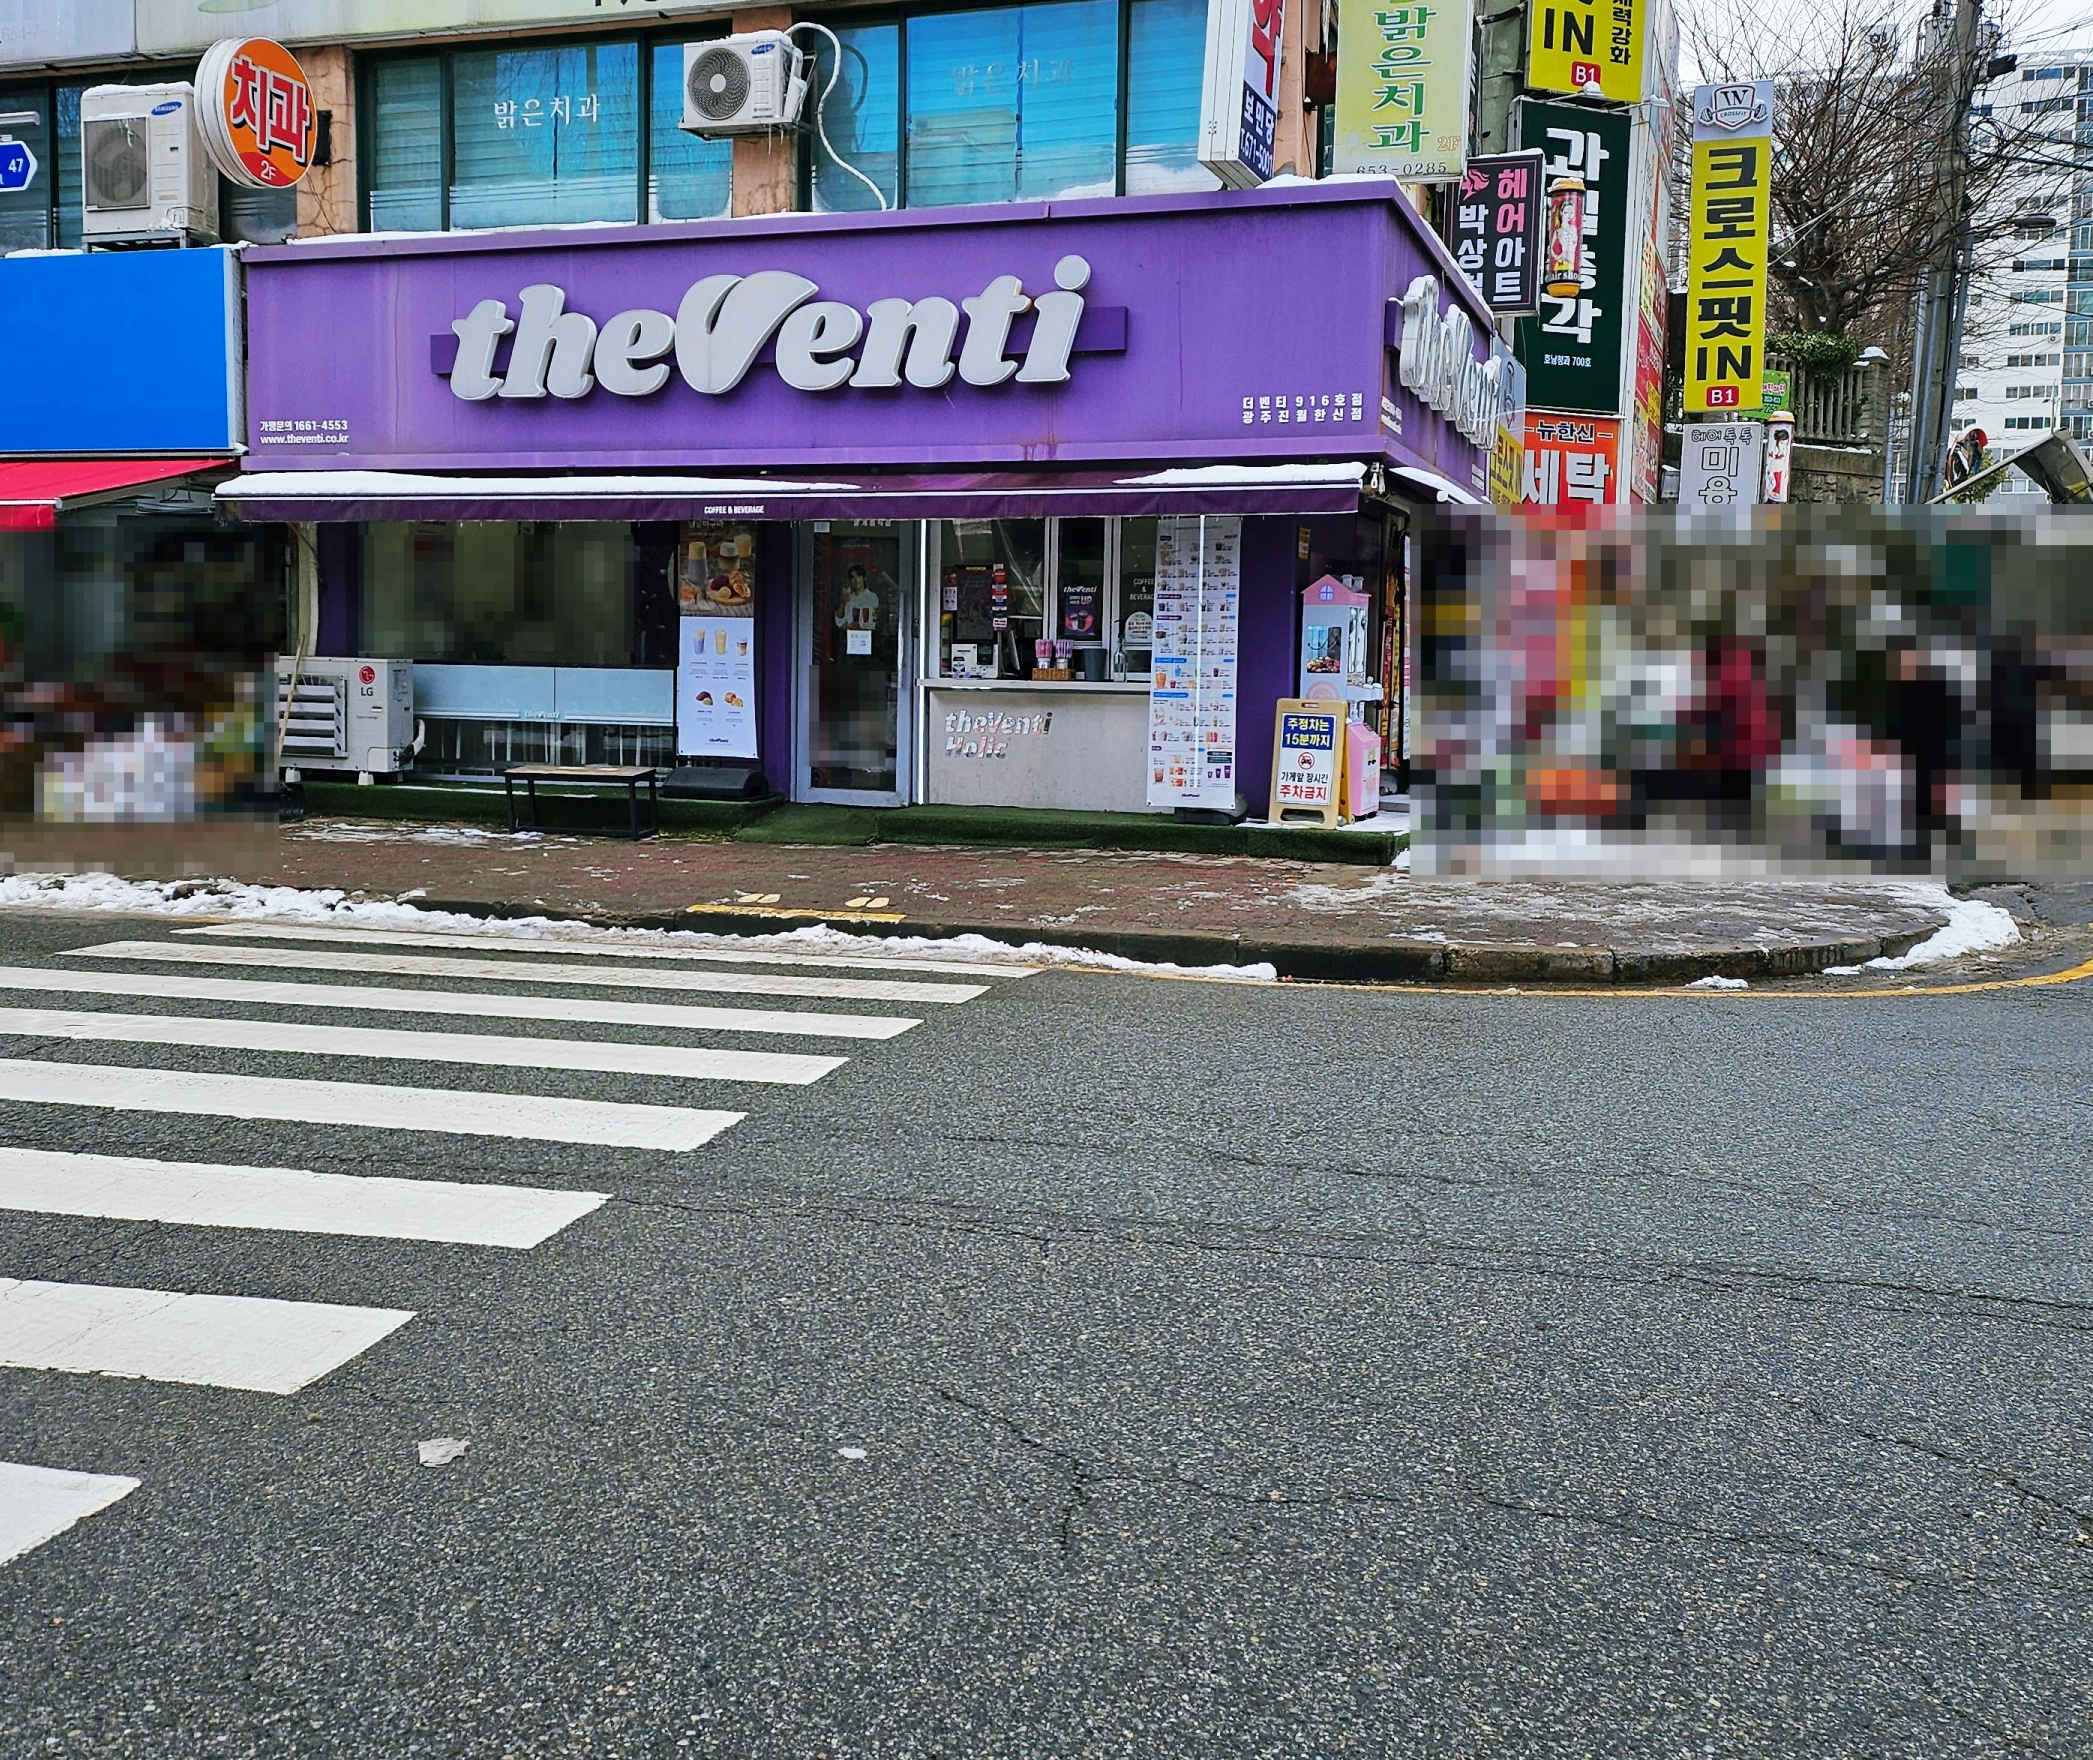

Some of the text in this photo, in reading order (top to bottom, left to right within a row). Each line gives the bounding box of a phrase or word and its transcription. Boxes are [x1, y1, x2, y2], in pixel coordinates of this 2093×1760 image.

[1543, 8, 1595, 56] IN
[1367, 6, 1437, 153] 밝은치과
[1575, 66, 1595, 82] B1
[231, 55, 310, 164] 치과
[493, 93, 600, 129] 밝은치과
[1243, 90, 1274, 145] 보민당
[1437, 136, 1461, 151] 2F
[8, 157, 24, 173] 47
[260, 160, 277, 180] 2F
[1357, 162, 1447, 174] 653-0285
[1492, 168, 1528, 302] 헤어아트
[1698, 147, 1757, 339] 크로스핏
[1572, 356, 1592, 368] 700호
[1697, 345, 1752, 381] IN
[1711, 389, 1734, 404] B1
[294, 420, 348, 431] 1661-4553
[1537, 420, 1595, 444] 뉴한신
[259, 433, 349, 444] www.theventi.co.kr
[704, 505, 727, 514] COFFEE
[733, 505, 764, 514] BEVERAGE
[1080, 595, 1093, 606] UP
[360, 687, 374, 697] LG
[1287, 717, 1330, 732] 주정차는
[945, 735, 1009, 759] Holic
[1284, 733, 1330, 748] 15분까지
[1306, 772, 1329, 784] 장시간
[1279, 784, 1328, 801] 주차금지
